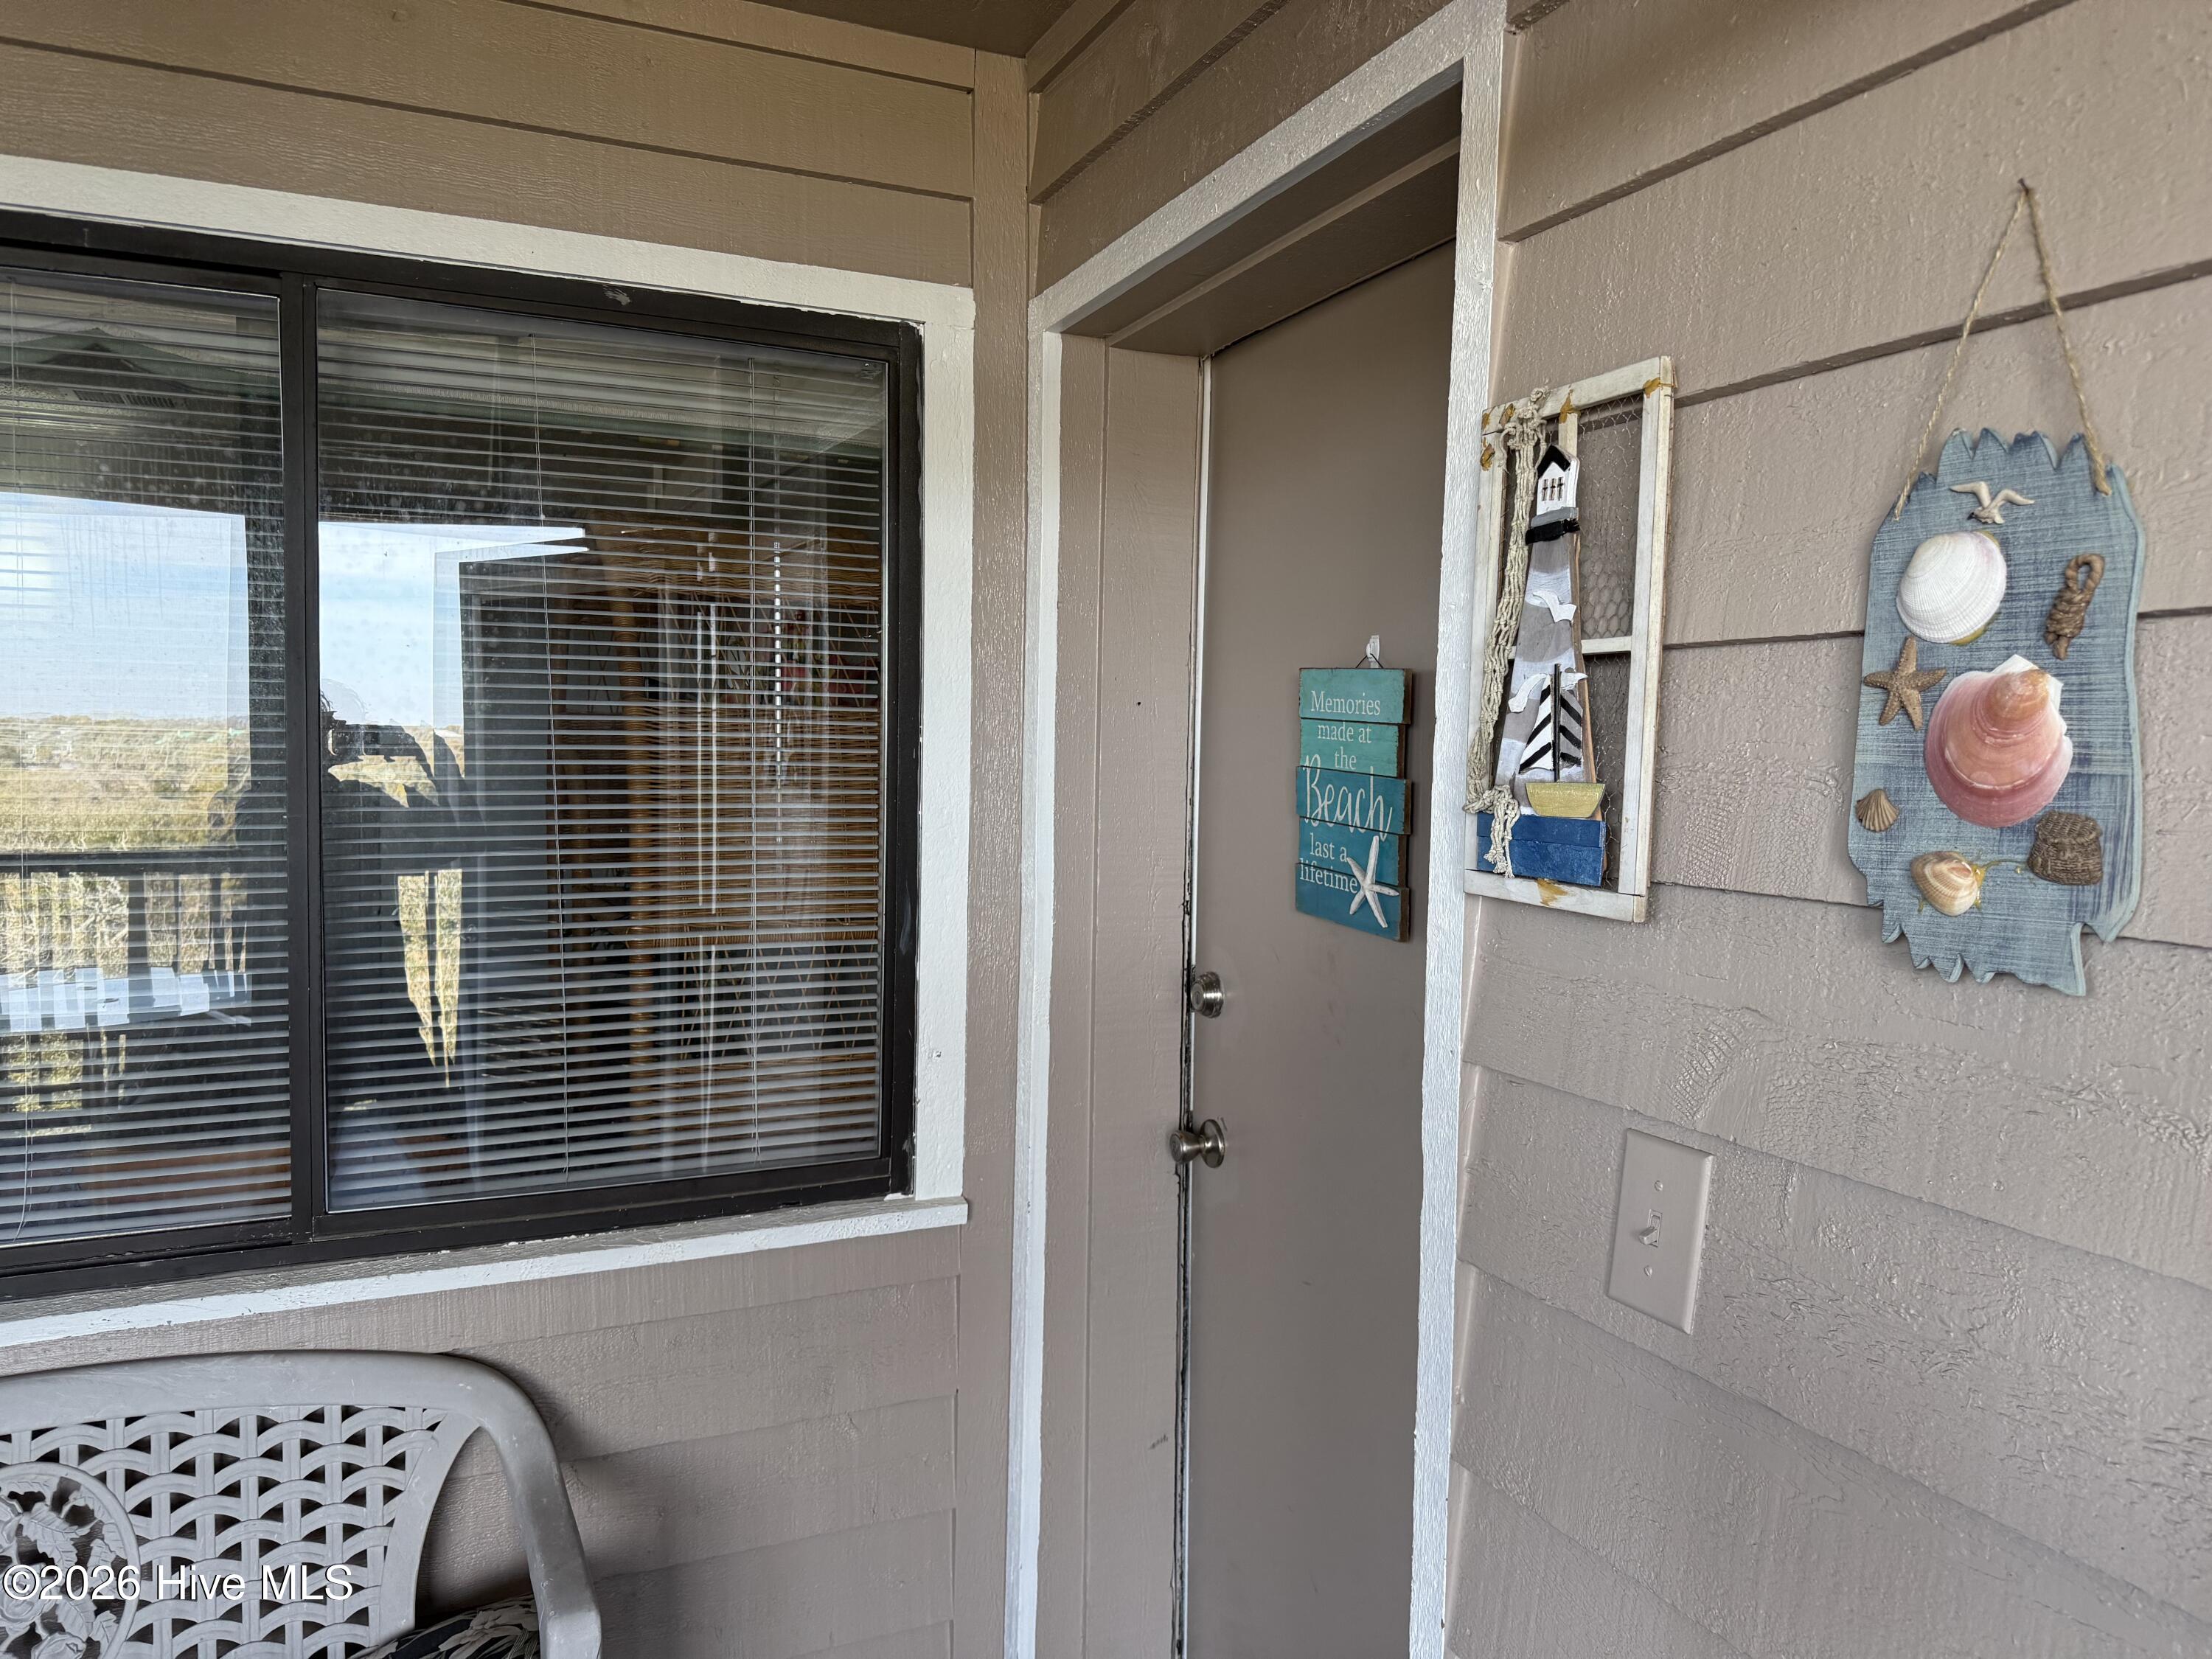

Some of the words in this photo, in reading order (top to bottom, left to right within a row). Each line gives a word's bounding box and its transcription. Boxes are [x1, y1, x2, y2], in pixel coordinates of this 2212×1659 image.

[1310, 690, 1381, 716] Memories
[1318, 721, 1354, 742] made
[1358, 725, 1372, 744] at
[1335, 746, 1357, 770] the
[1302, 754, 1393, 842] Beach
[1310, 832, 1335, 859] last
[1340, 846, 1346, 862] a
[1299, 858, 1358, 894] lifetime
